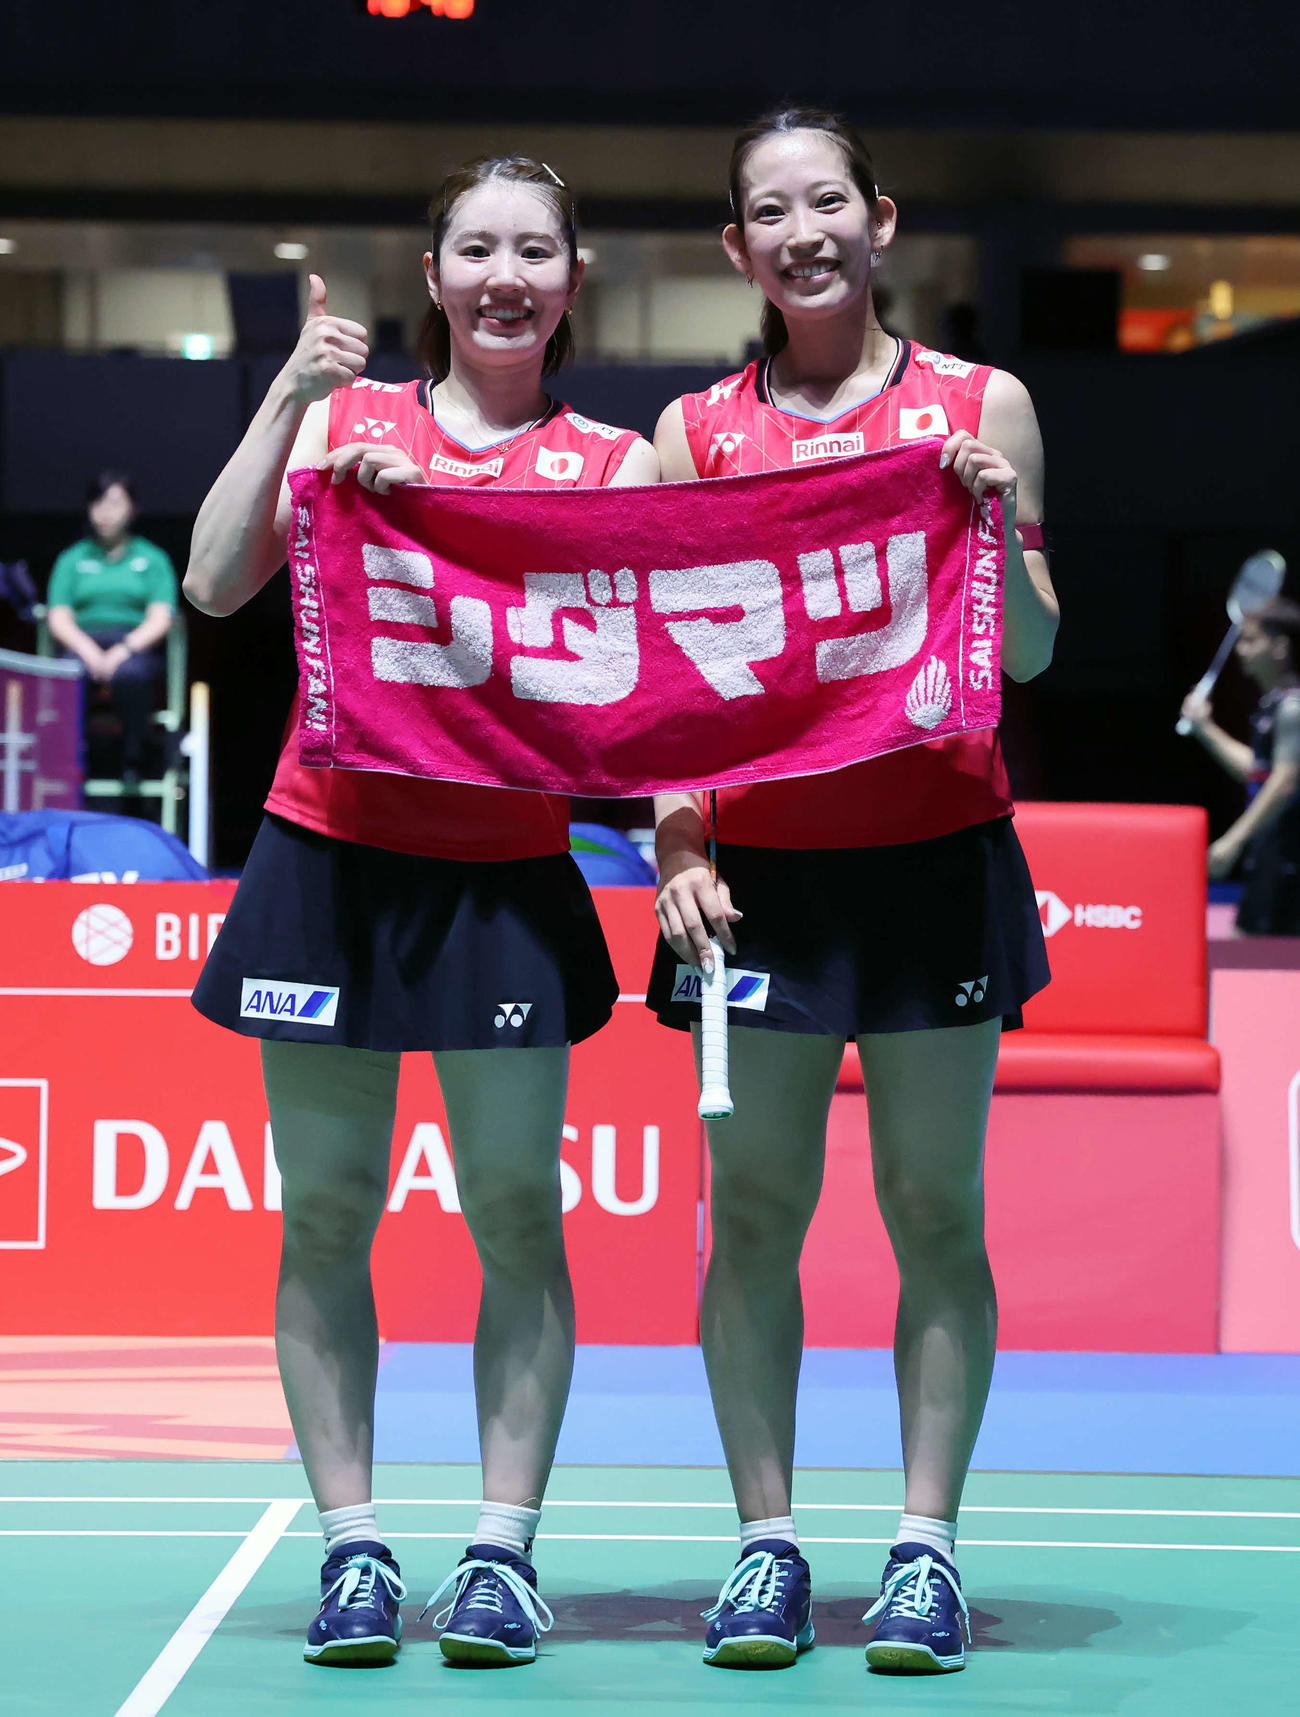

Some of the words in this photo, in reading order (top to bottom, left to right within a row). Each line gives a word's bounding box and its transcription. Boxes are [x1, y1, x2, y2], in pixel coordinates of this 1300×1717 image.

[796, 435, 861, 458] Rinnai
[434, 457, 500, 475] Rinnai
[362, 530, 928, 706] シダマツ
[1074, 903, 1143, 929] HSBC
[674, 974, 703, 998] AN
[244, 989, 297, 1017] ANA
